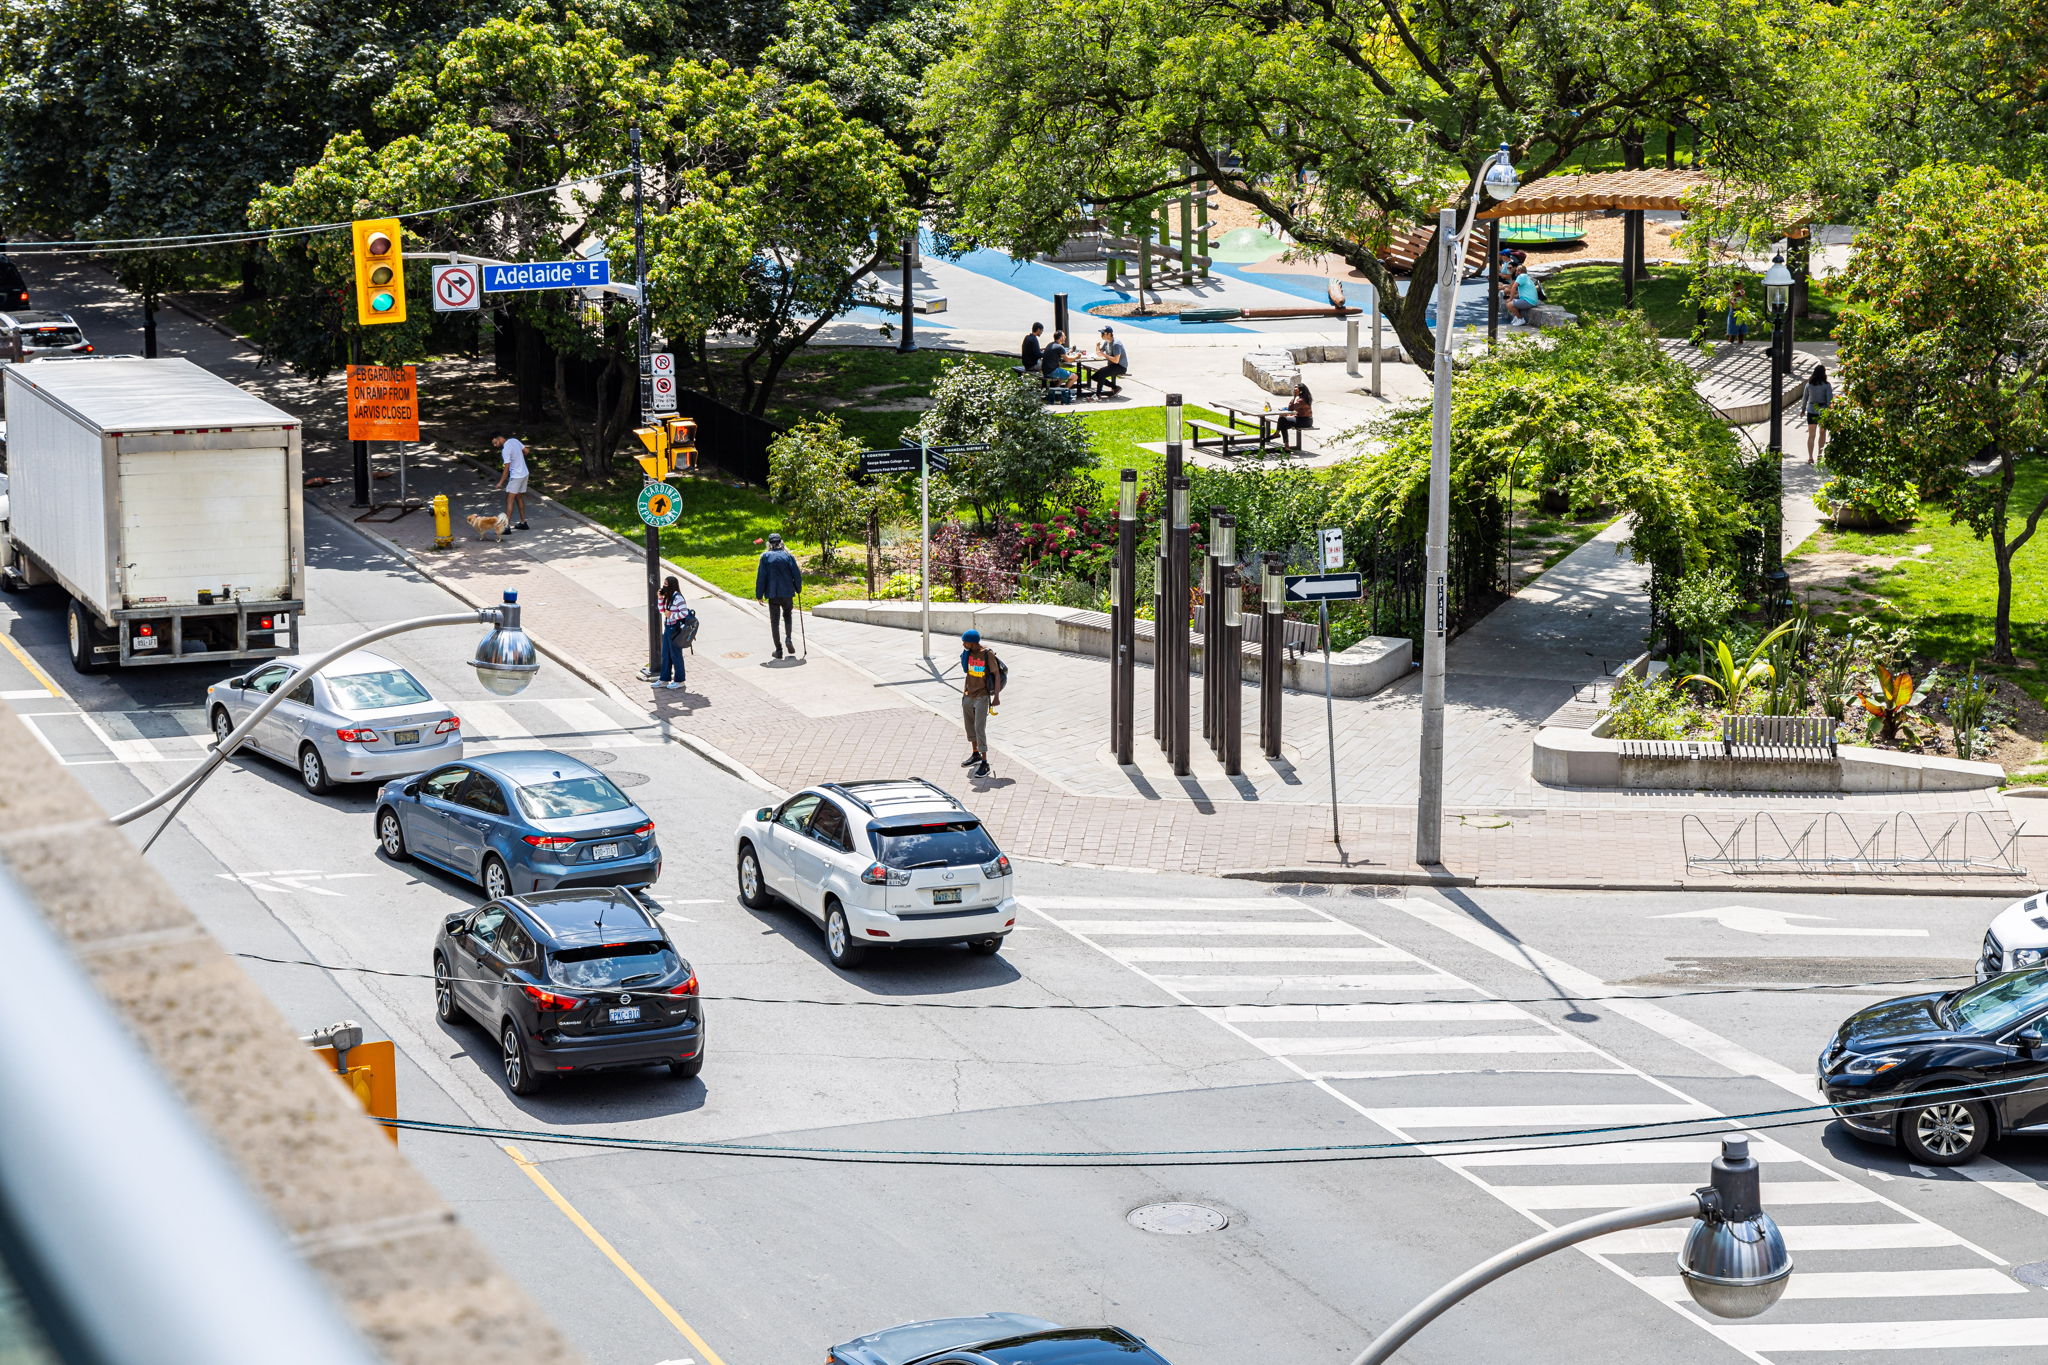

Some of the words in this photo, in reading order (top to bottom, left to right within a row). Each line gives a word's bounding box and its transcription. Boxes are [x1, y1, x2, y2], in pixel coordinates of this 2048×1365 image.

[494, 265, 572, 285] Adelaide
[576, 264, 585, 273] St
[589, 263, 600, 280] E
[356, 367, 366, 381] EB
[367, 367, 406, 382] GARDINER
[354, 386, 365, 400] ON
[366, 387, 387, 400] RAMP
[388, 387, 410, 401] FROM
[354, 405, 380, 419] JARVIS
[381, 406, 412, 420] CLOSED
[644, 485, 680, 504] GARDINER
[639, 501, 679, 526] EXPRESSWAY
